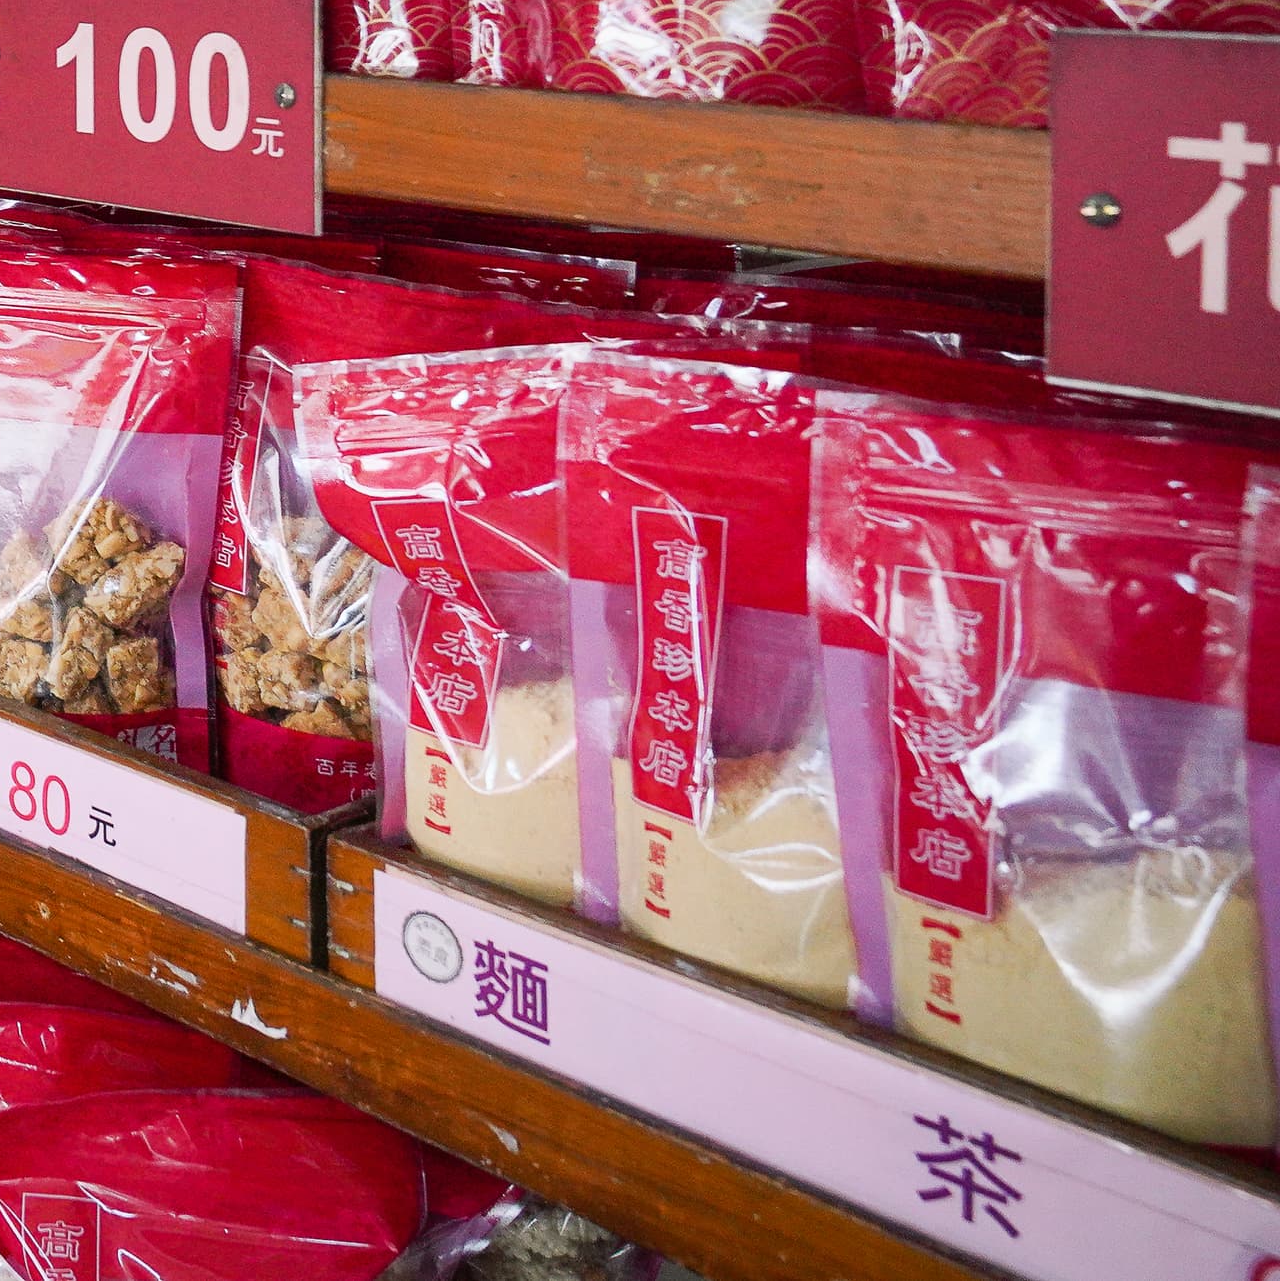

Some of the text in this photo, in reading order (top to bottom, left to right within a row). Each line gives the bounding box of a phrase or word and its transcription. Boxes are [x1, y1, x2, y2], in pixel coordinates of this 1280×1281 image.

[55, 22, 285, 158] 100元
[639, 539, 708, 788] 高香珍本店
[9, 760, 116, 848] 80元
